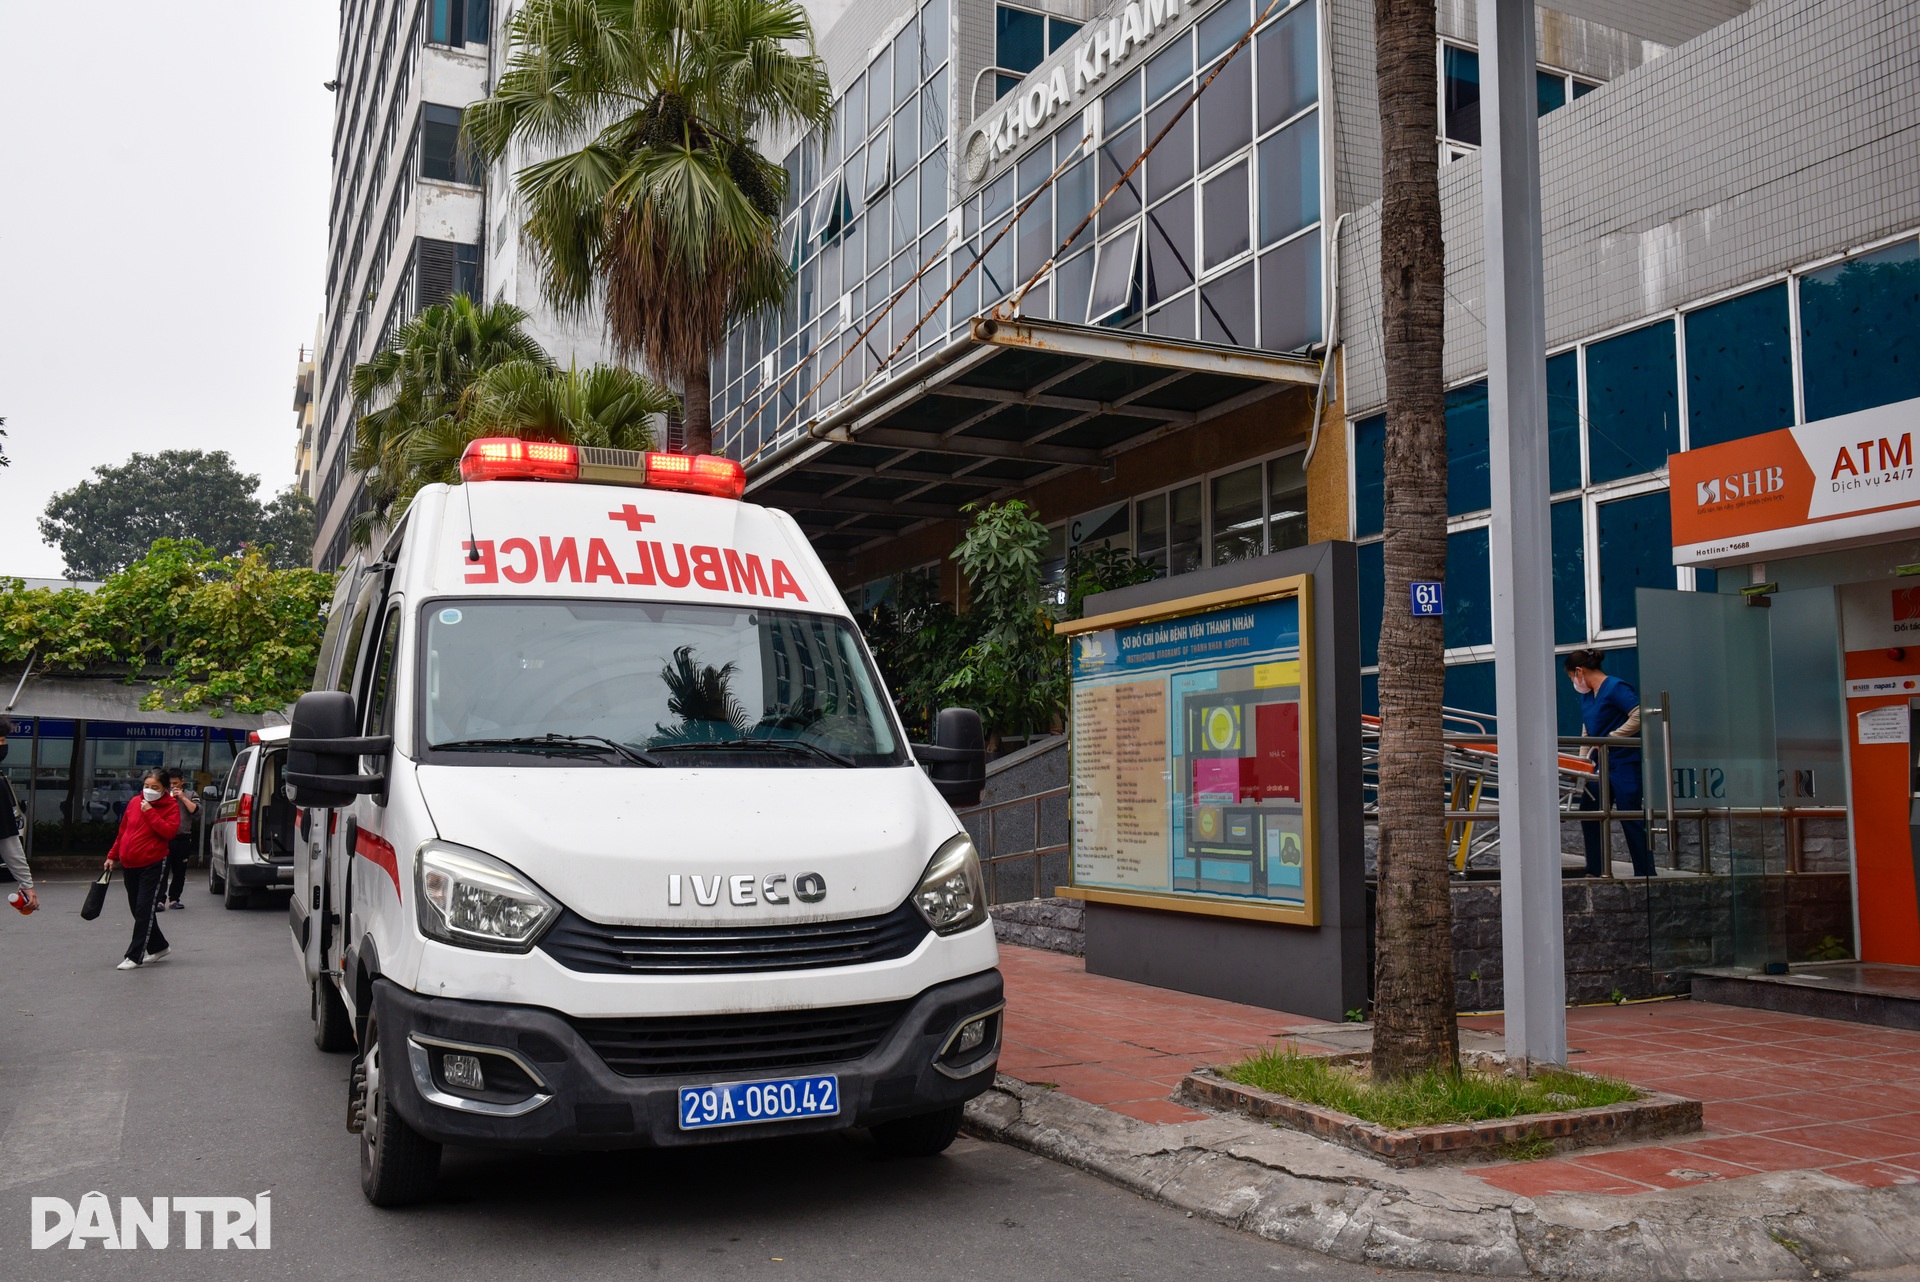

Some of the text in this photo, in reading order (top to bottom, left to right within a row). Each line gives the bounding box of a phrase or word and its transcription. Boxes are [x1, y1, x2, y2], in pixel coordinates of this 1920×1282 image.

[989, 65, 1070, 162] KHOA
[1831, 432, 1912, 480] ATM
[1725, 466, 1784, 501] SHB
[1832, 468, 1913, 493] Dịch vụ 24/7
[1071, 520, 1082, 543] C
[1696, 546, 1728, 556] Hotline:
[1416, 585, 1438, 604] 61
[1122, 634, 1131, 650] SƠ
[1155, 625, 1169, 644] DẪN
[1170, 625, 1188, 643] BỆNH
[1188, 621, 1205, 640] VIỆN
[1206, 618, 1231, 635] THANH
[1232, 613, 1255, 631] NHÀN
[1157, 646, 1181, 659] DIAGRAMS
[1182, 645, 1189, 655] OF
[1224, 636, 1250, 649] HOSPITAL
[24, 725, 31, 734] 2
[126, 725, 147, 736] NHÀ
[149, 724, 181, 737] THUỐC
[184, 725, 197, 737] SỐ
[667, 871, 827, 906] IVECO
[684, 1080, 835, 1124] 29A-060.42
